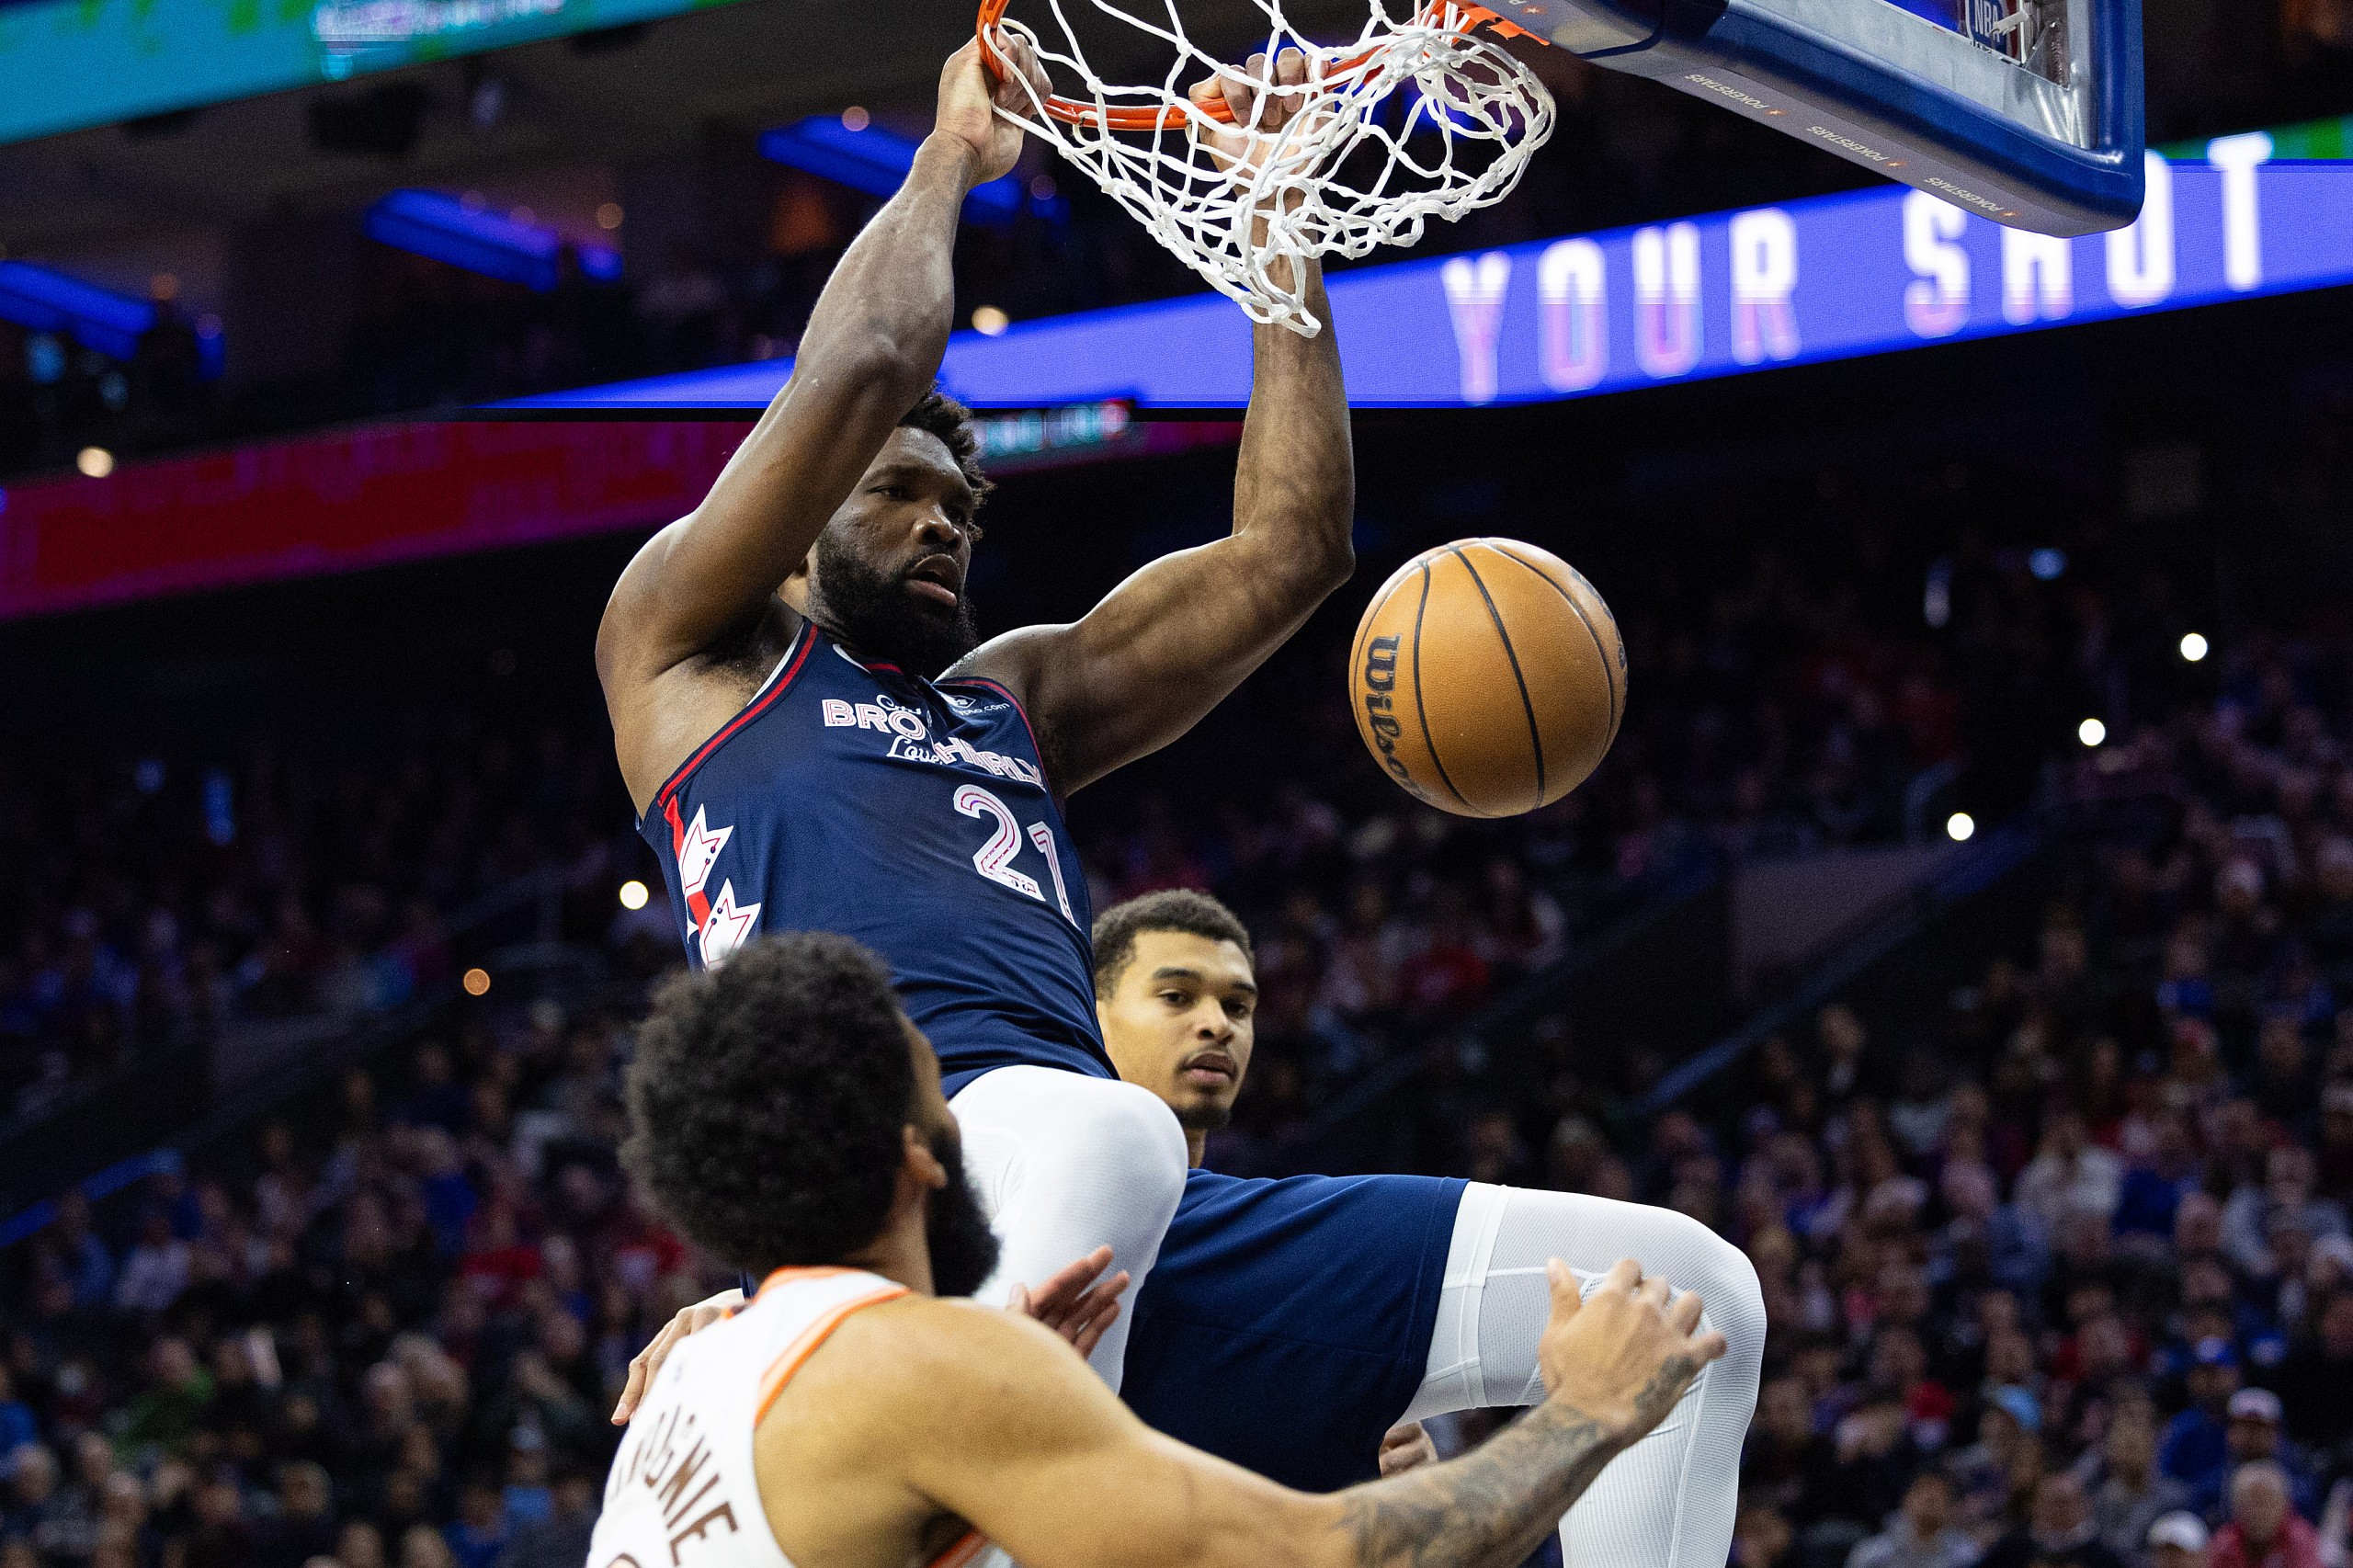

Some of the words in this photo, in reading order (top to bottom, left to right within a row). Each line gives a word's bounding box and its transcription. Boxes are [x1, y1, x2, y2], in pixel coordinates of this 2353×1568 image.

[1975, 0, 2001, 42] NBA
[1684, 74, 1769, 110] POKERSTARS
[1806, 126, 1889, 162] POKERSTARS
[1924, 176, 2006, 212] POKERSTARS
[1440, 205, 1802, 406] YOUR
[1902, 131, 2273, 337] SHOT
[1365, 632, 1424, 800] Wilso
[953, 784, 1082, 931] 21
